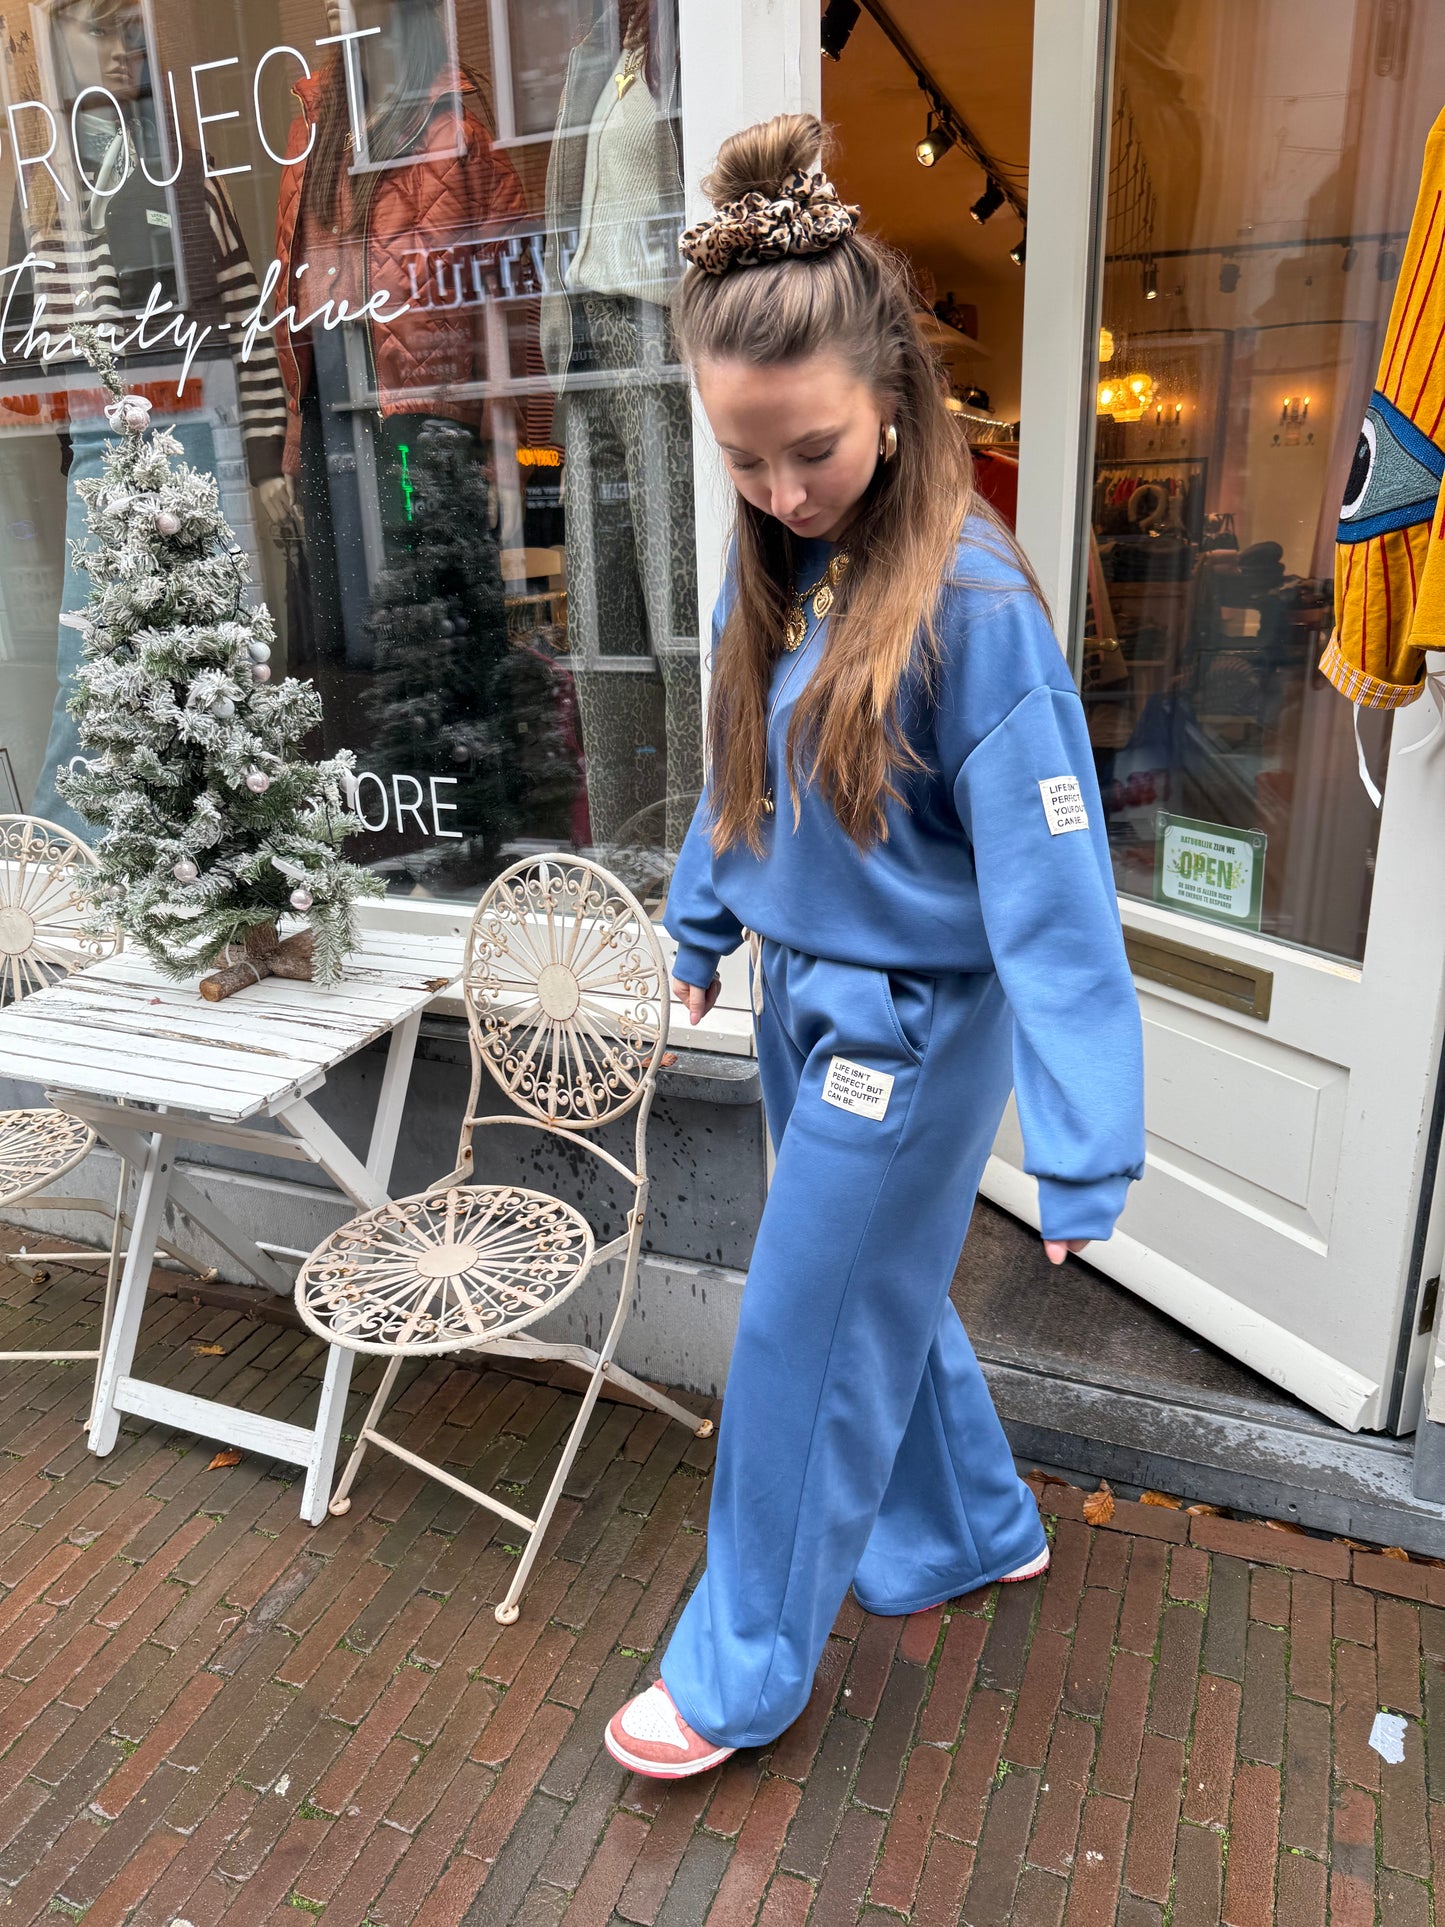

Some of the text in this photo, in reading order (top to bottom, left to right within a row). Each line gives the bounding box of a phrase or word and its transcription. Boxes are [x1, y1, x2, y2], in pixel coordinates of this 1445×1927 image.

[0, 26, 381, 209] ROJECT
[1049, 783, 1067, 794] LIFE
[1180, 851, 1233, 890] OPEN
[832, 1071, 884, 1095] PERFECT BUT
[834, 1062, 871, 1081] LIFE ISN'T
[827, 1089, 856, 1107] CAN BE.
[830, 1080, 880, 1104] YOUR OUTFIT
